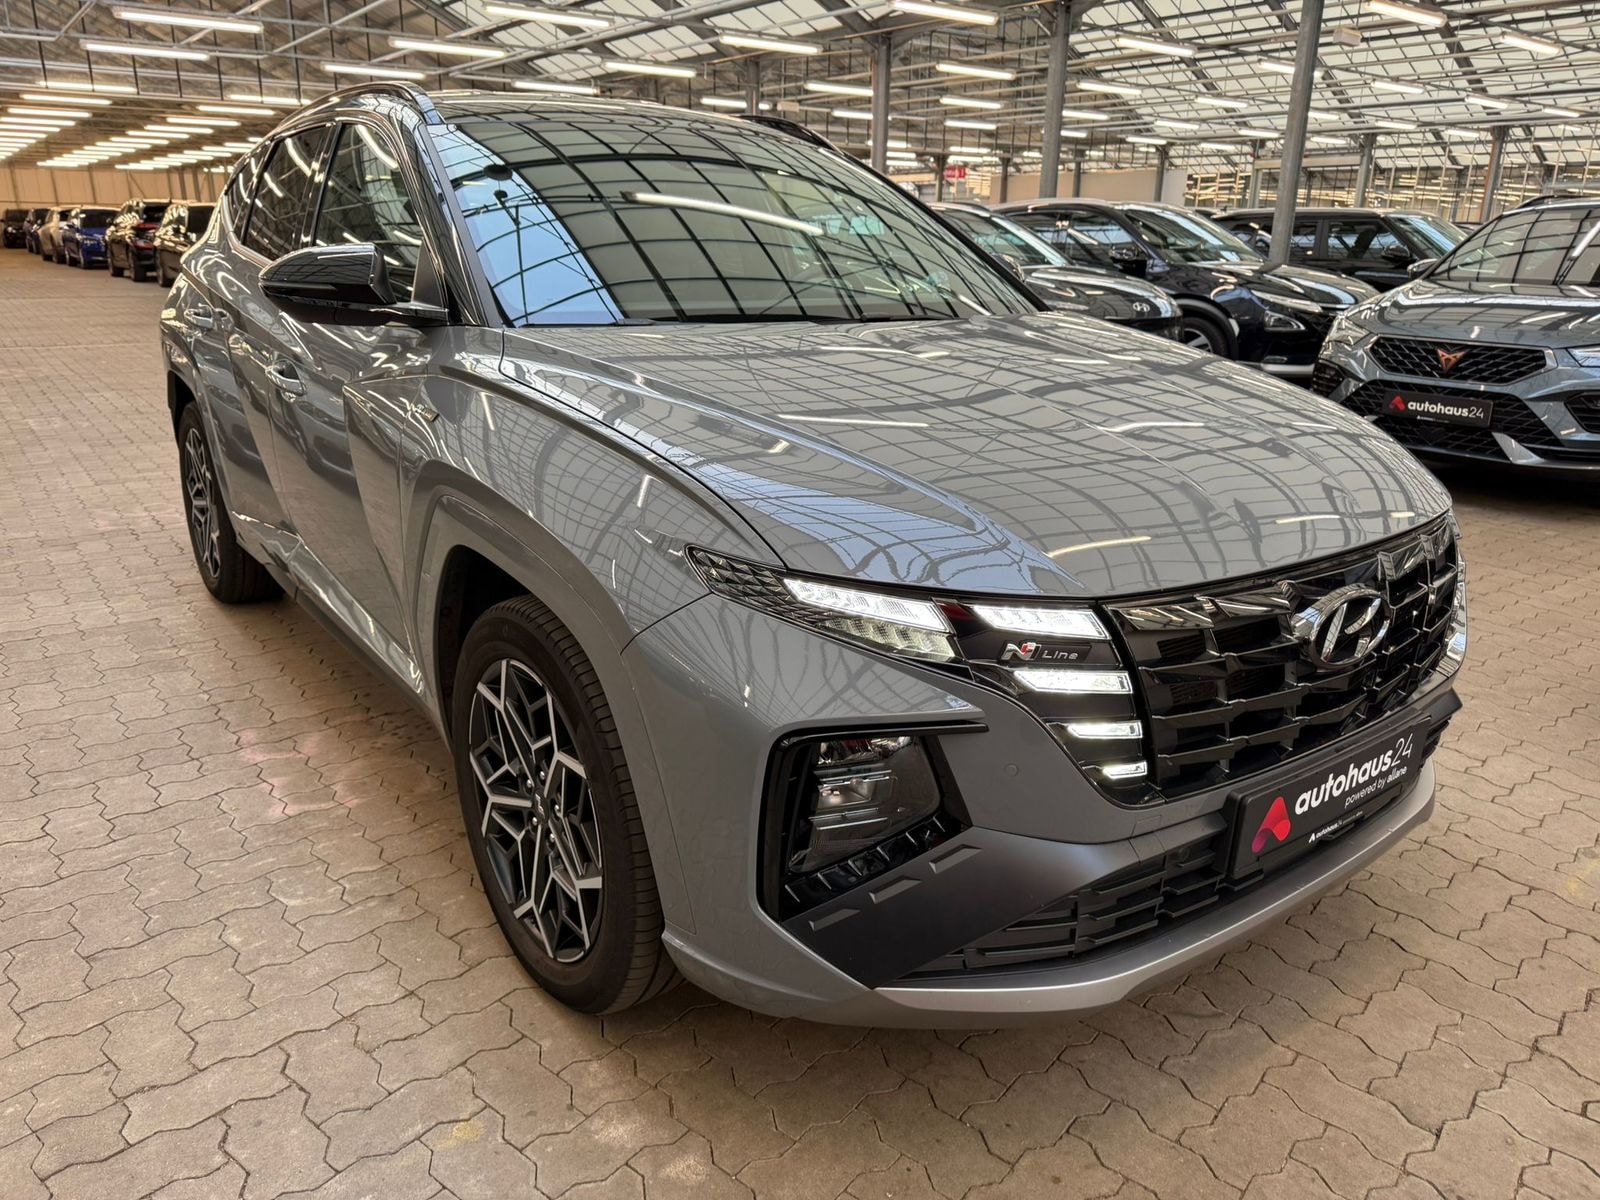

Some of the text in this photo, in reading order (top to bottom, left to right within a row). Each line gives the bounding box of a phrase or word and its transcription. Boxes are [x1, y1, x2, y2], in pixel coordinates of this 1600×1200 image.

[1407, 401, 1484, 419] autohaus24
[1042, 650, 1079, 660] Line
[1294, 733, 1414, 815] autohaus24
[1344, 766, 1408, 809] powered by allane
